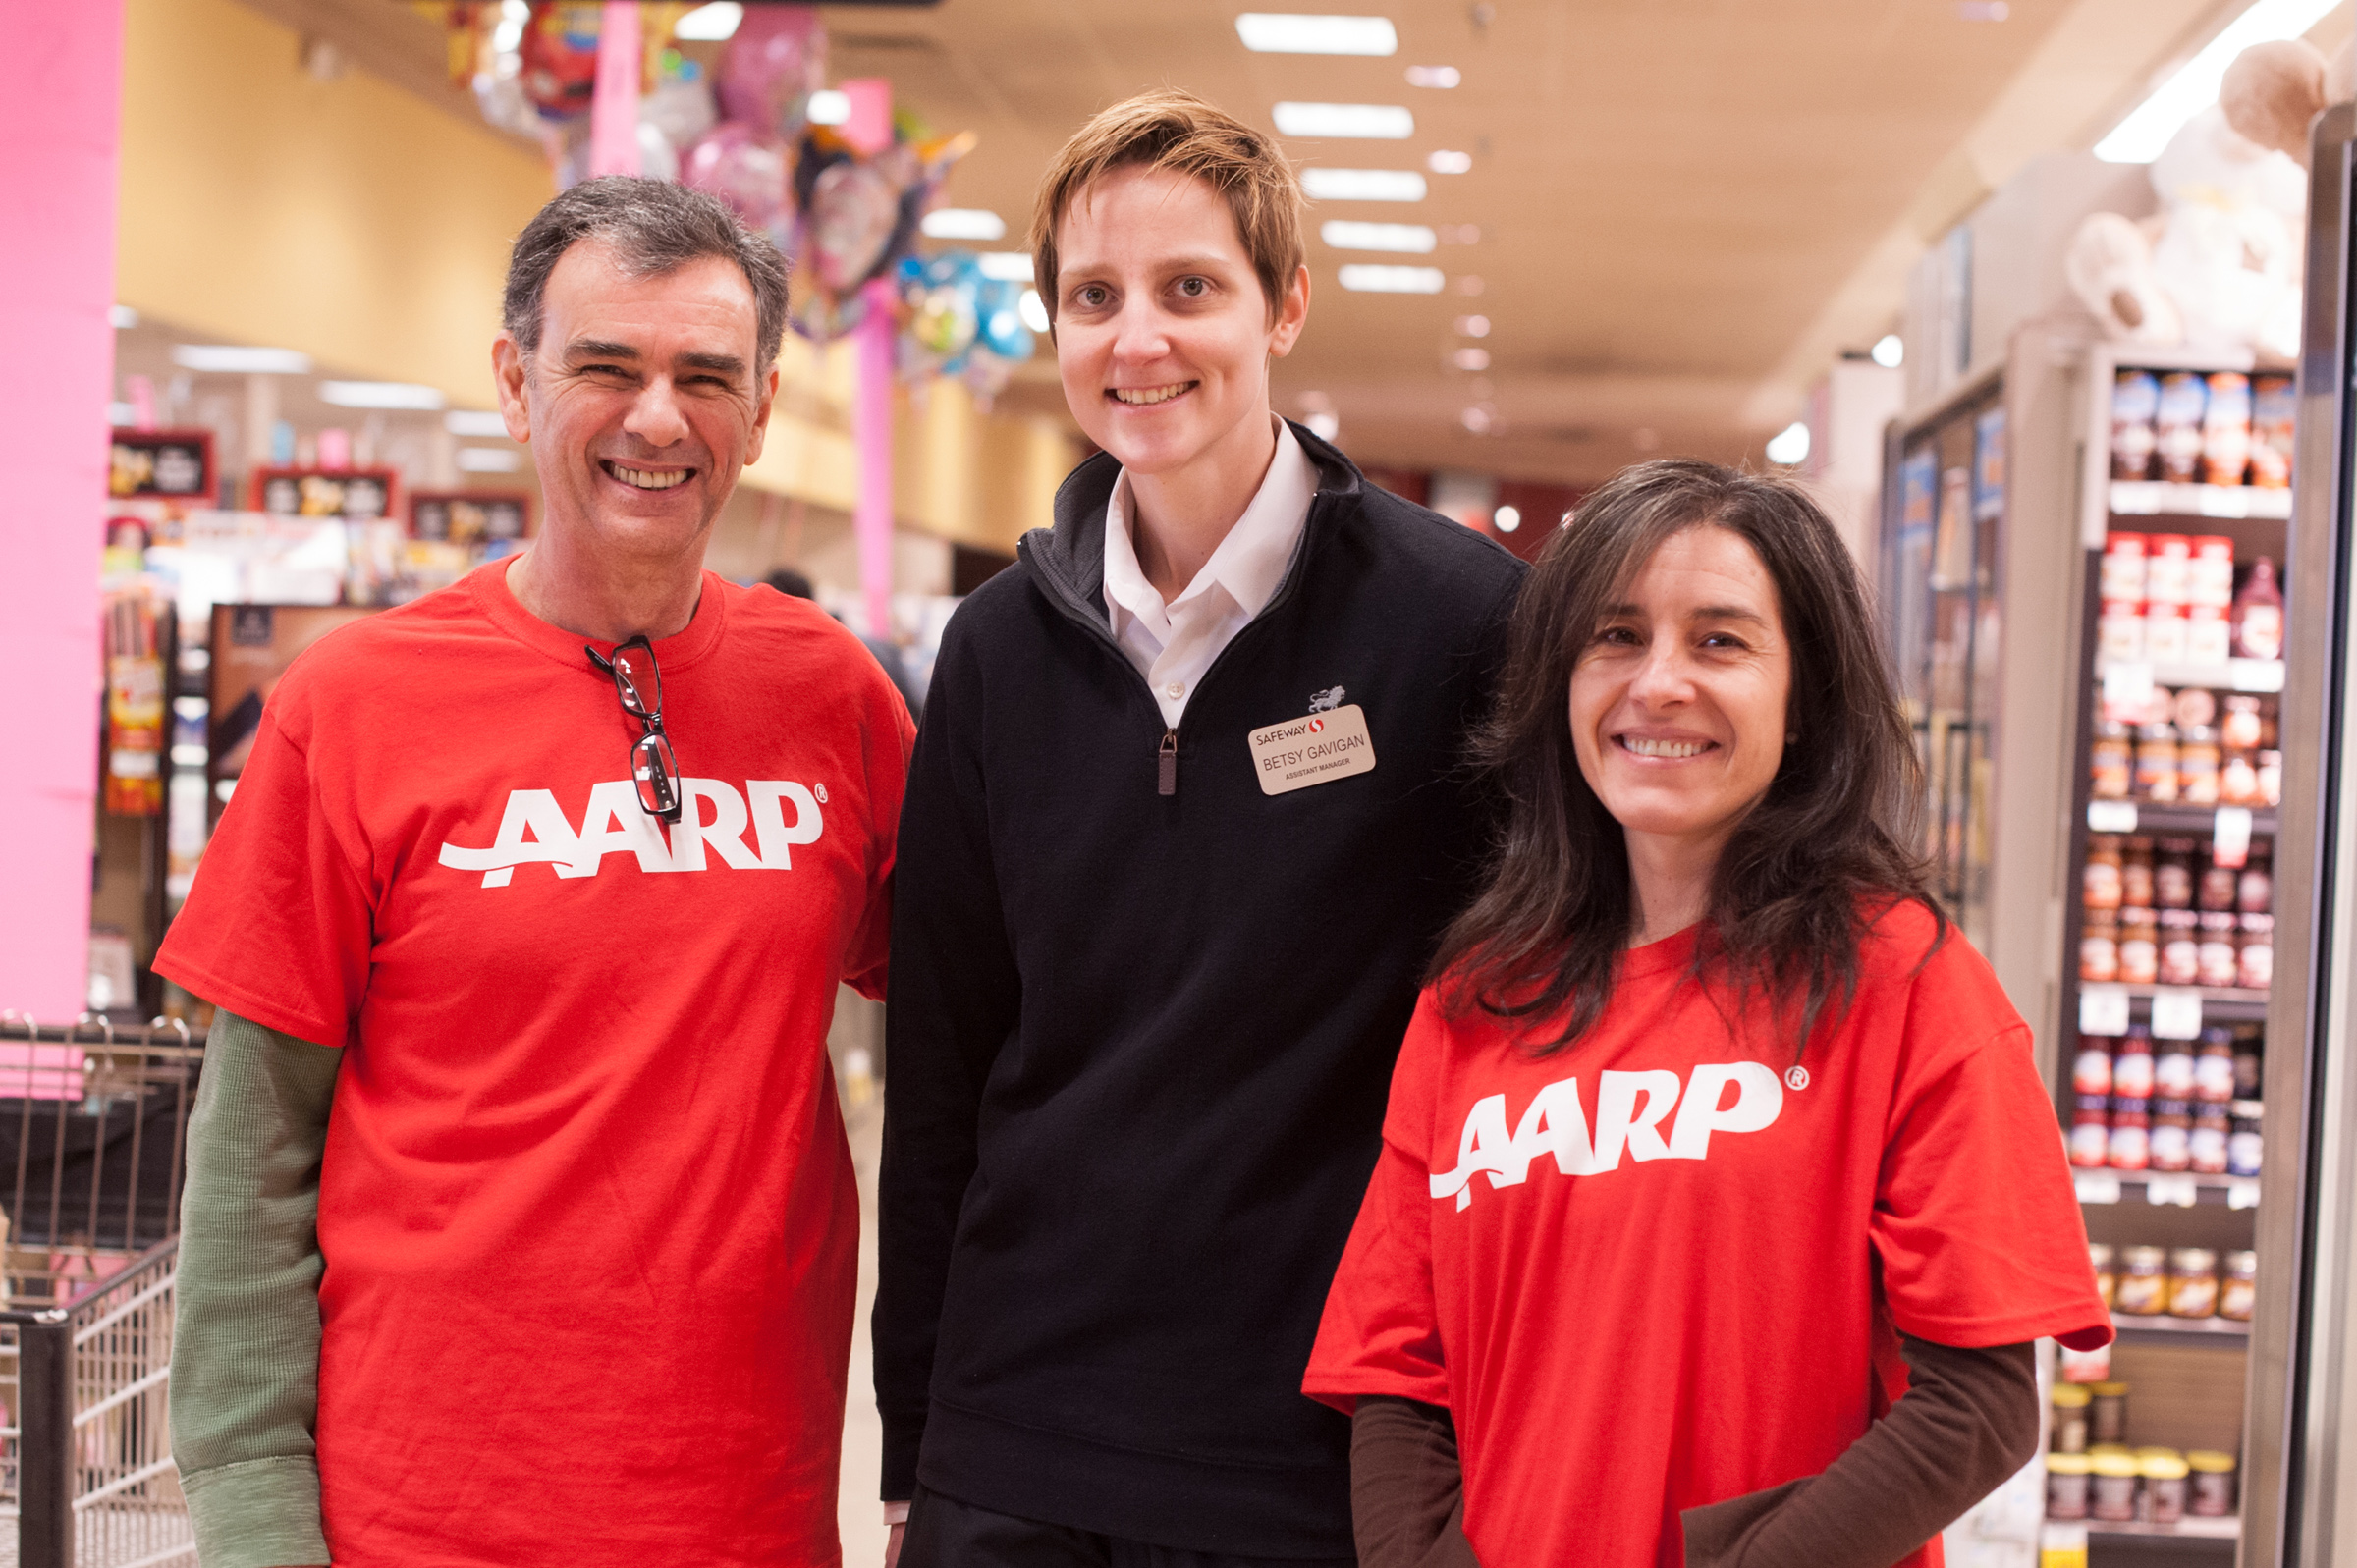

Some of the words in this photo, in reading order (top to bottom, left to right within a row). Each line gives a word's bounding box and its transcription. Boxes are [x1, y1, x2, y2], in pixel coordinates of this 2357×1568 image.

[1256, 724, 1306, 746] SAFEWAY
[1263, 749, 1303, 771] BETSY
[1307, 734, 1365, 759] GAVIGAN
[1285, 766, 1318, 780] ASSISTANT
[1319, 758, 1350, 771] MANAGER
